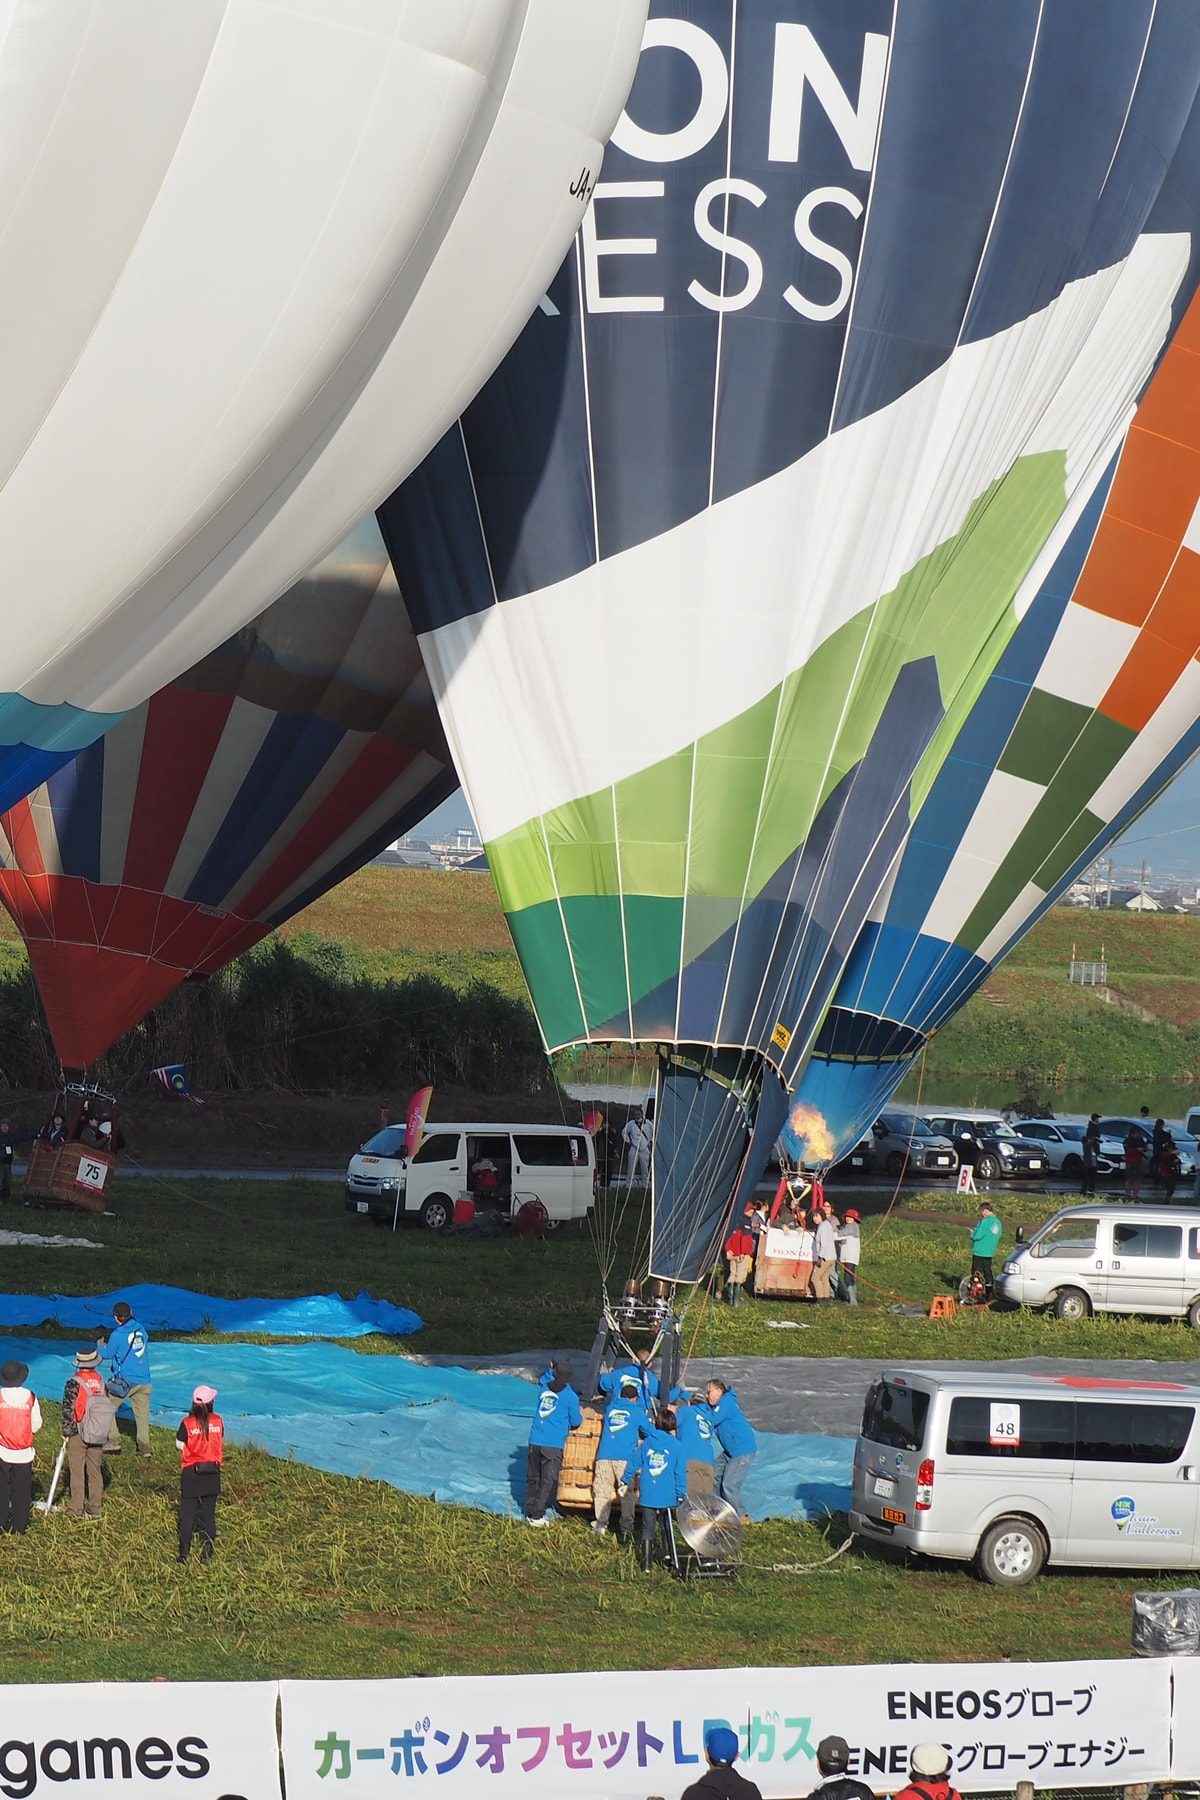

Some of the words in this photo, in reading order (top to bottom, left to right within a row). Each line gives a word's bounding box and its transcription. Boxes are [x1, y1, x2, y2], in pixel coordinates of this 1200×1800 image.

[538, 177, 864, 322] ESS
[85, 1163, 101, 1181] 75
[959, 1169, 969, 1188] B
[995, 1422, 1016, 1436] 48
[887, 1684, 1097, 1720] ENEOSグローブ
[846, 1736, 1145, 1775] ENESグローブエナジー
